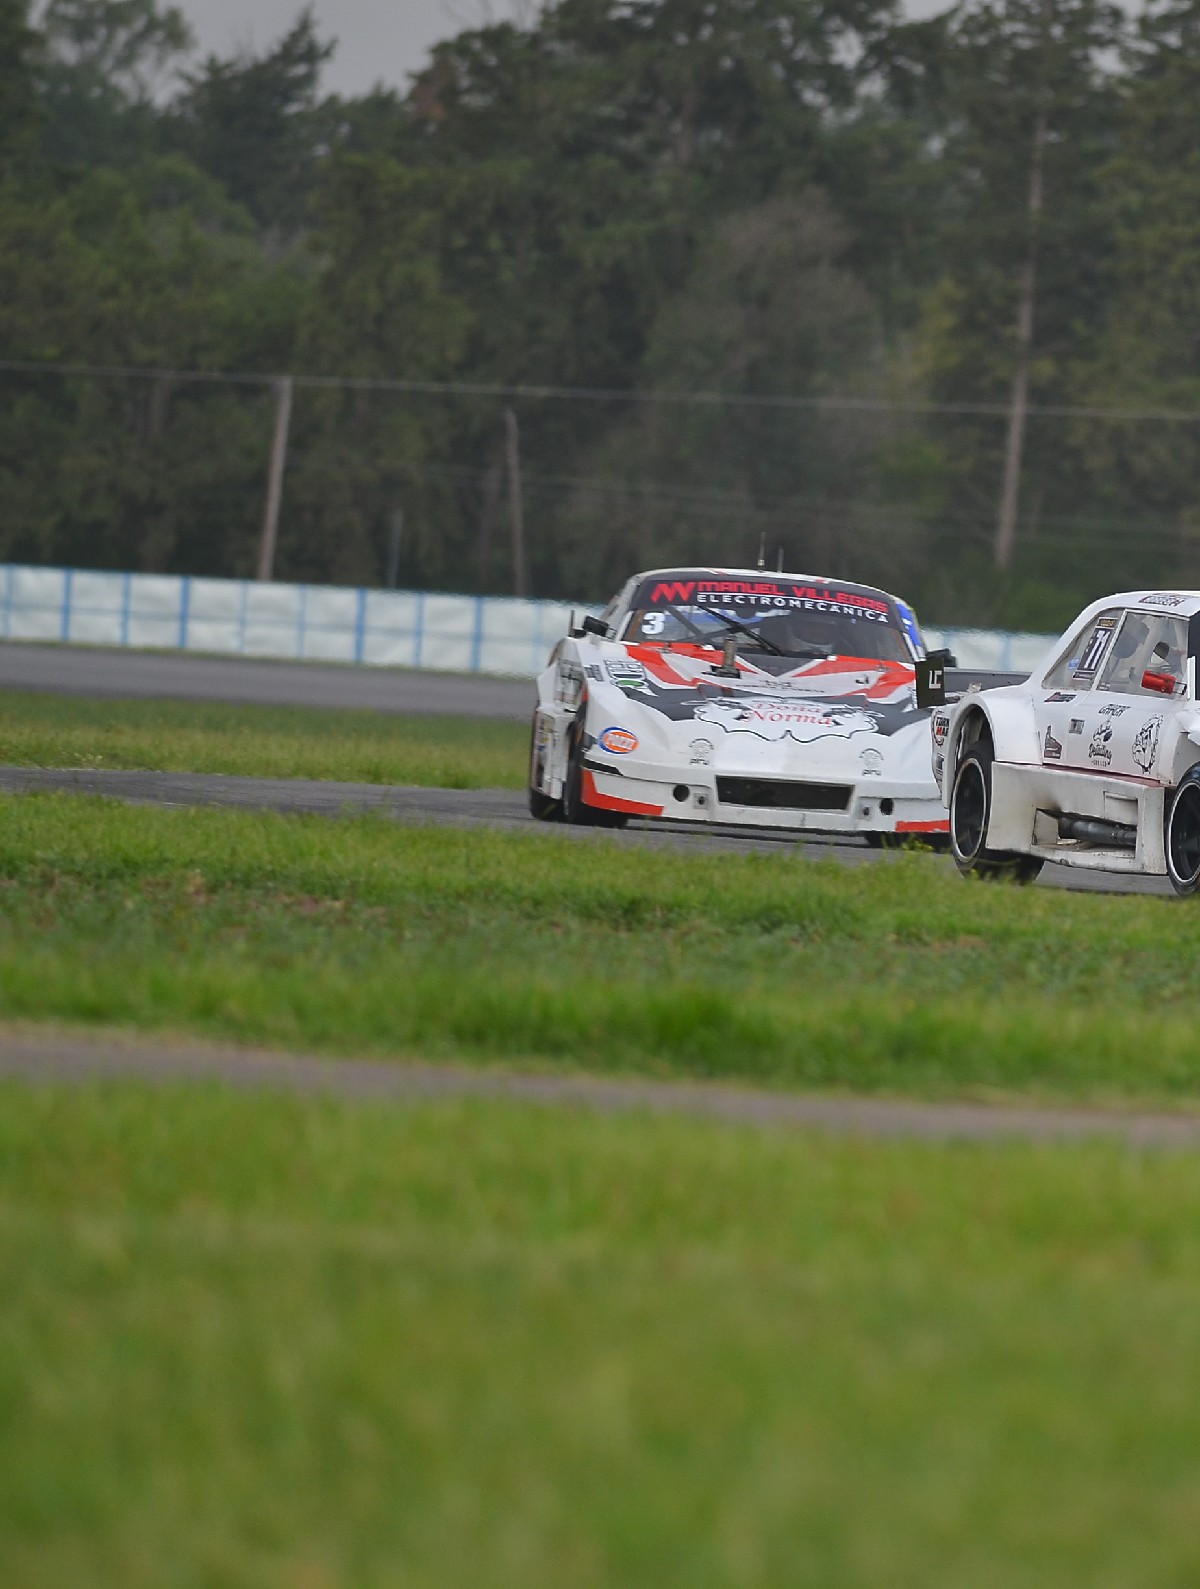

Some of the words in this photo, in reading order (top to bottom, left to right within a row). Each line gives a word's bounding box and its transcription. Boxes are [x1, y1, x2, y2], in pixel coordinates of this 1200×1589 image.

[697, 581, 785, 596] MANUEL
[792, 587, 890, 613] VILLEGAS
[697, 594, 889, 624] ELECTROMECANICA
[641, 612, 666, 635] 3
[744, 711, 833, 726] Norma
